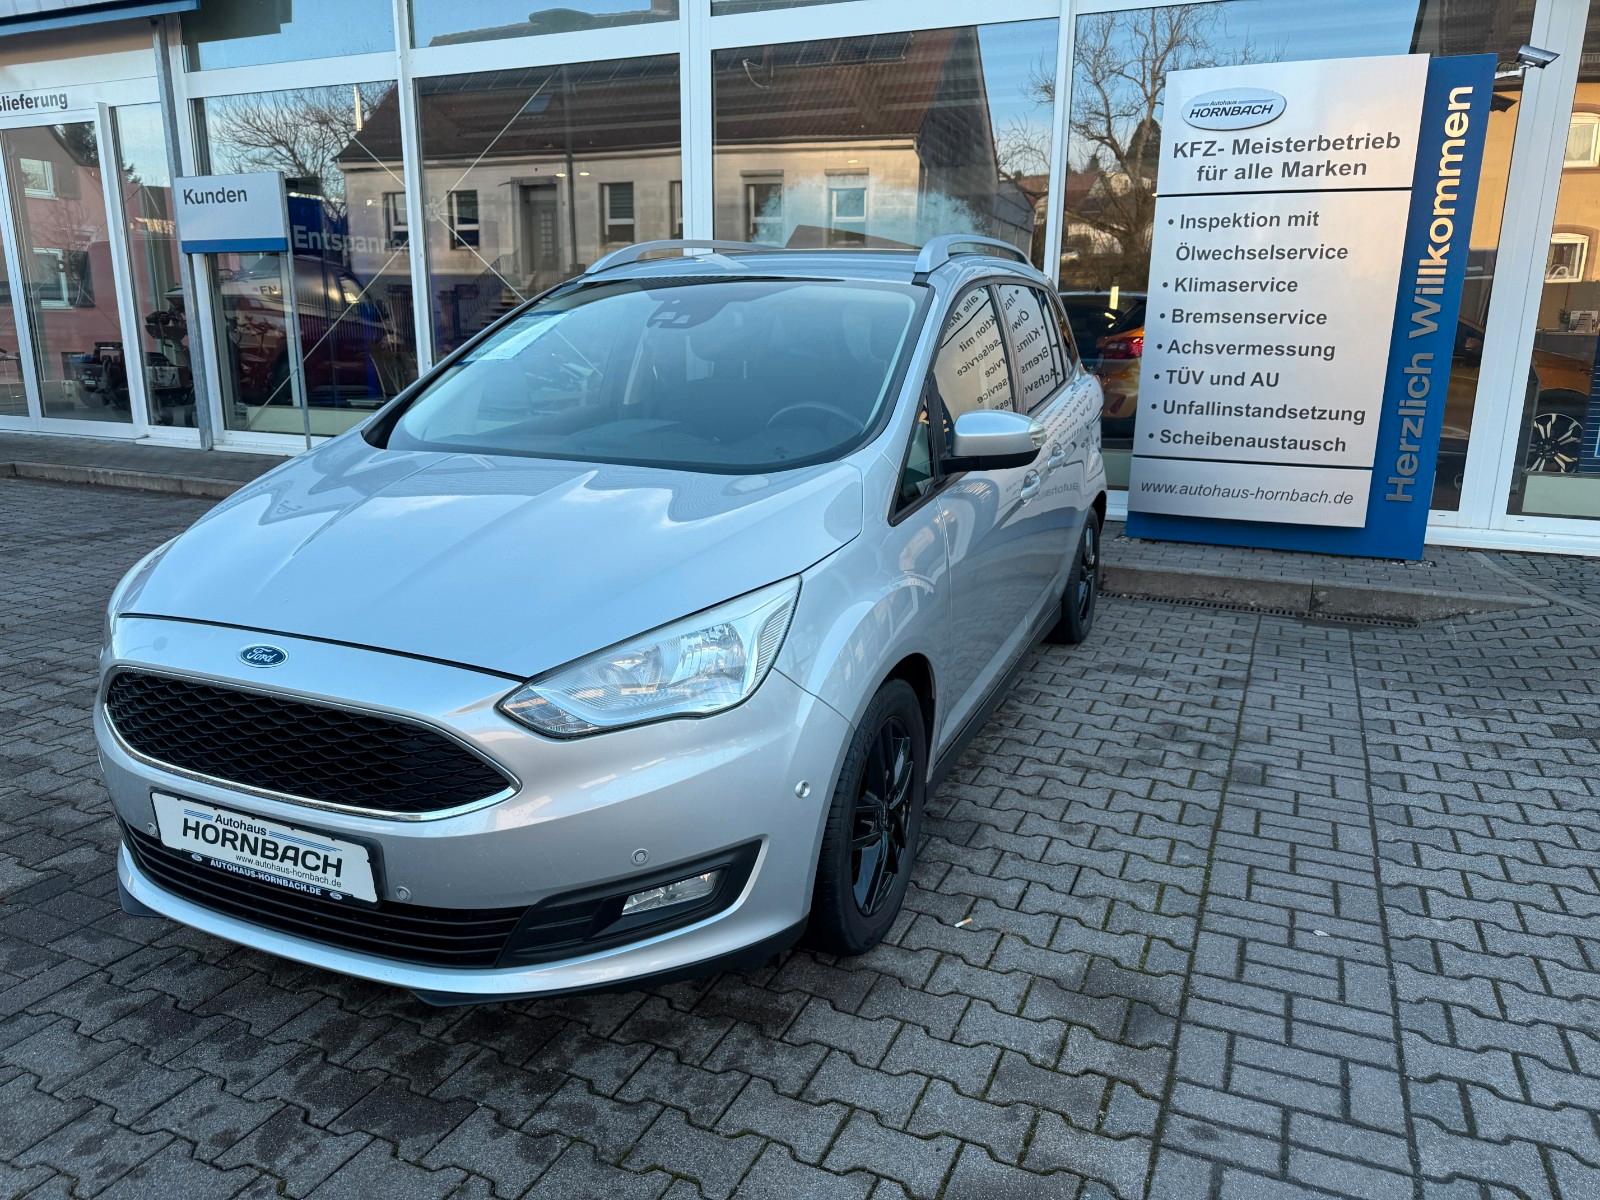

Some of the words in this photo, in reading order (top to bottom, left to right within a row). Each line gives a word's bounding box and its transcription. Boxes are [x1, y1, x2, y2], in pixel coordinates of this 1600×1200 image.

[1189, 104, 1274, 119] HORNBACH
[1173, 140, 1225, 159] KFZ-
[1232, 131, 1401, 156] Meisterbetrieb
[1197, 164, 1225, 182] für
[1234, 162, 1273, 180] alle
[1281, 160, 1368, 178] Marken
[183, 187, 248, 205] Kunden
[1180, 212, 1281, 232] Inspektion
[1287, 211, 1320, 228] mit
[1408, 86, 1474, 339] Willkommen
[1175, 242, 1348, 262] Ölwechselservice
[1174, 277, 1299, 293] Klimaservice
[1171, 309, 1327, 326] Bremsenservice
[1167, 339, 1336, 362] Achsvermessung
[1166, 366, 1205, 385] TÜV
[1210, 371, 1246, 387] und
[1250, 372, 1280, 388] AU
[1163, 399, 1366, 426] Unfallinstandsetzung
[1386, 352, 1435, 502] Herzlich
[1160, 429, 1347, 452] Scheibenaustausch
[1140, 480, 1354, 505] www.autohaus-hornbach.de
[246, 647, 278, 662] Ford
[215, 814, 267, 836] Autohaus
[182, 817, 343, 878] HORNBACH
[210, 859, 322, 896] AUTOHAUS-HORNBACH.DE
[235, 853, 342, 888] www.autohaus-hornbach.de
